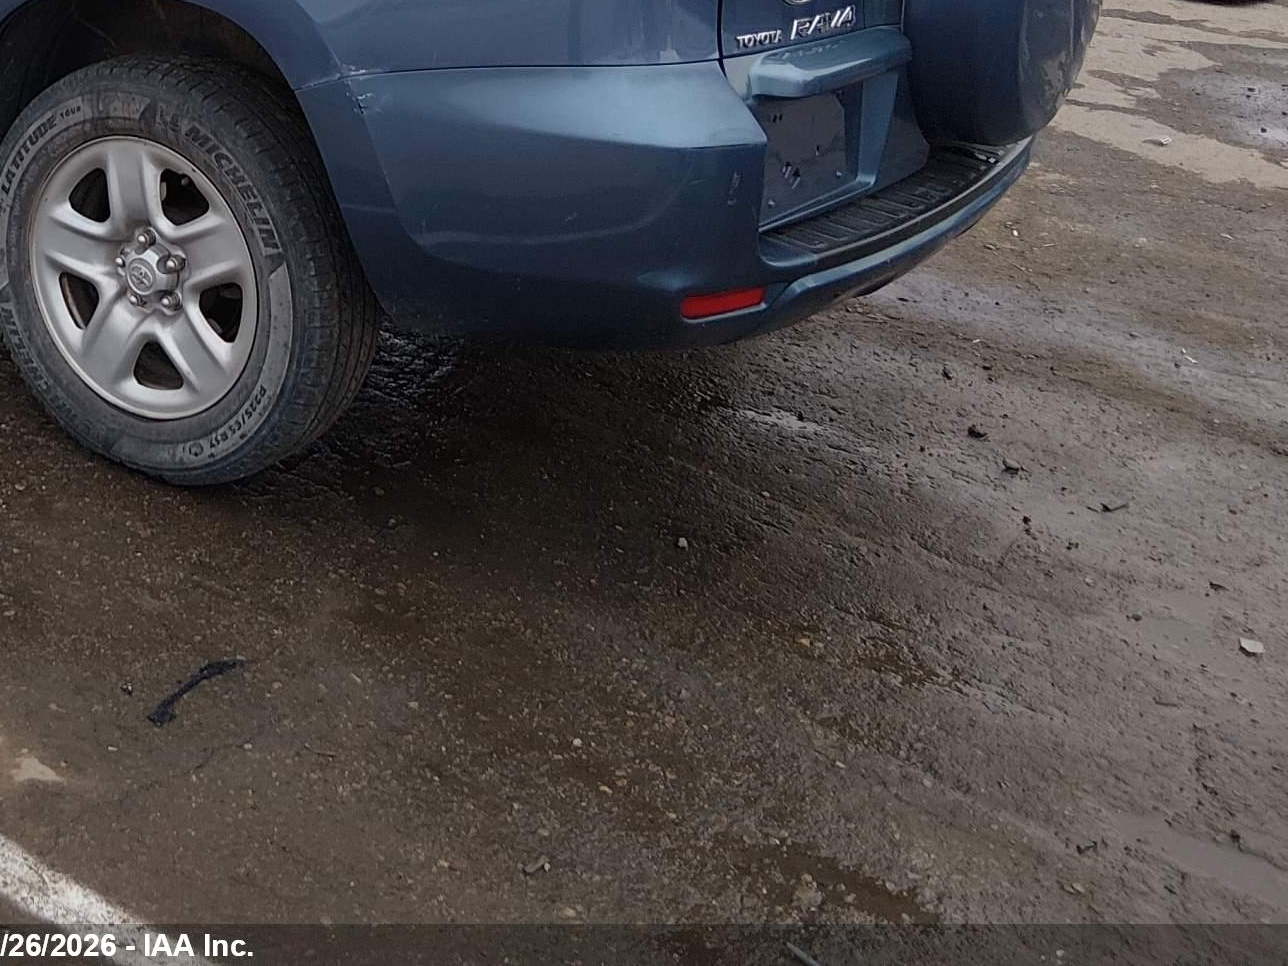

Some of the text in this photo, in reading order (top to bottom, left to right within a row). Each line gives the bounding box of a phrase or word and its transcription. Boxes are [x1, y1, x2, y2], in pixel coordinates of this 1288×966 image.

[735, 5, 856, 49] TOYOTA RAV4
[1, 114, 58, 195] LATITUDE
[184, 124, 281, 251] MICHELIN
